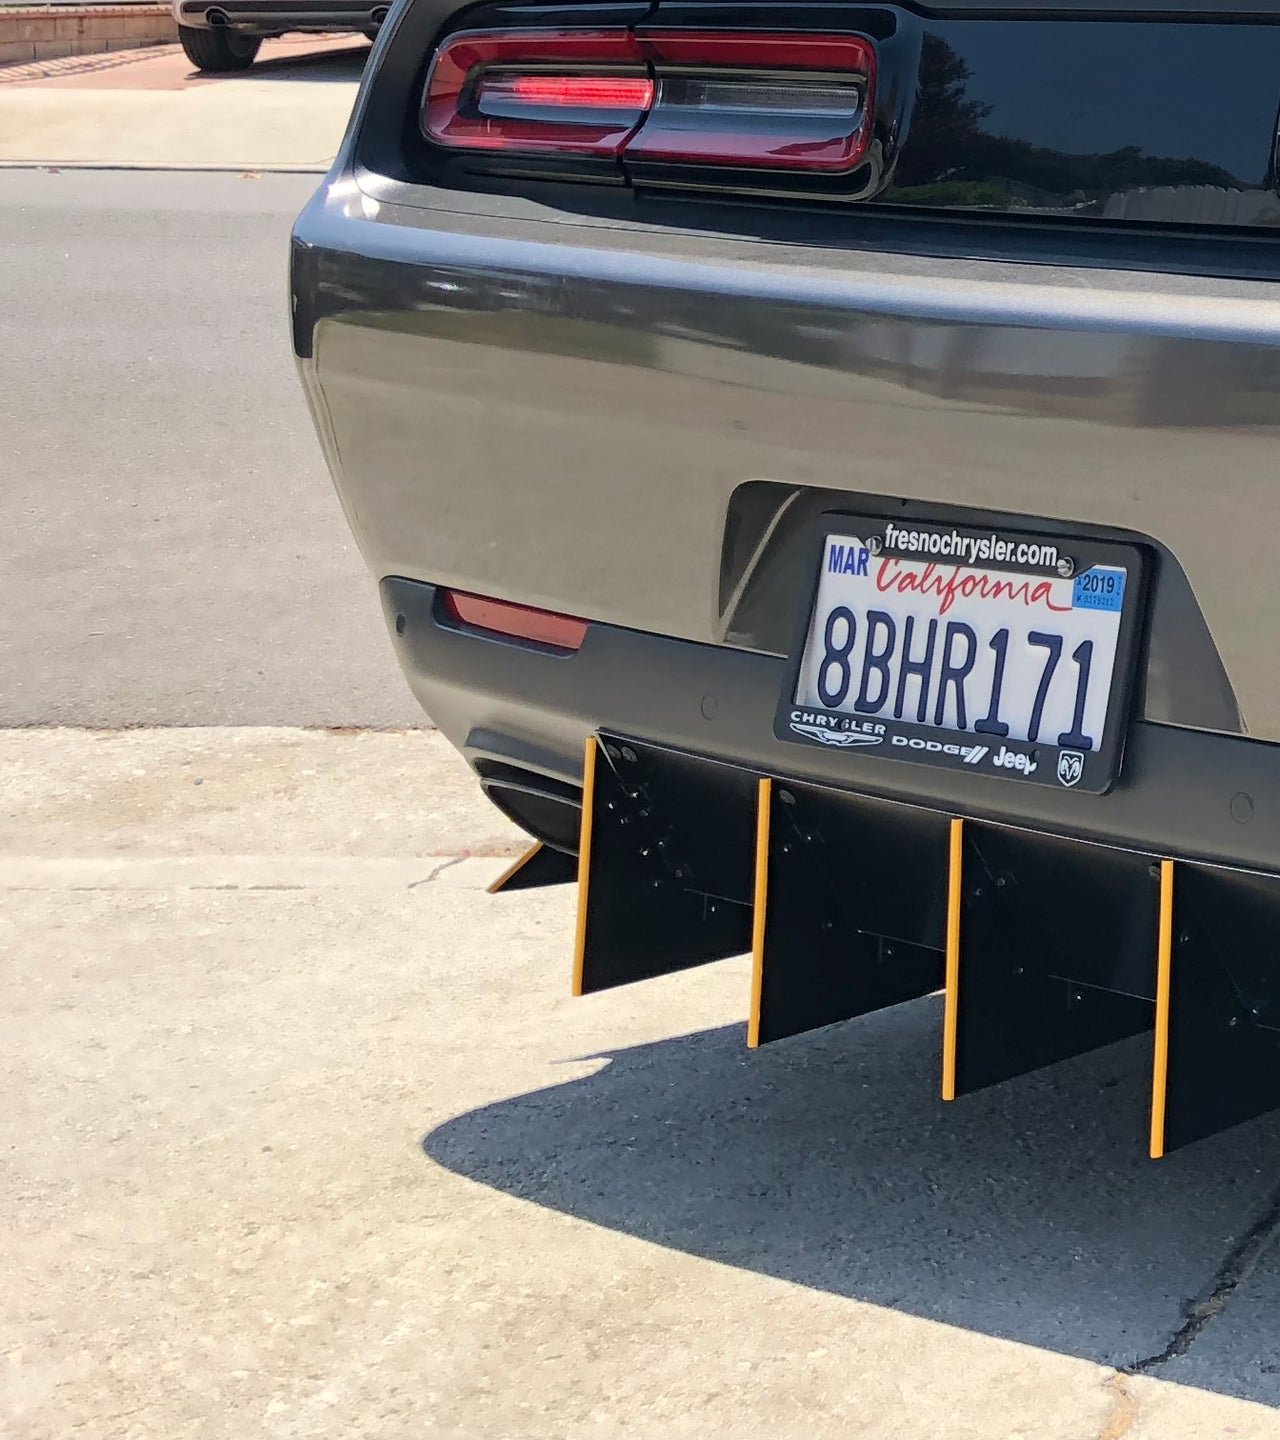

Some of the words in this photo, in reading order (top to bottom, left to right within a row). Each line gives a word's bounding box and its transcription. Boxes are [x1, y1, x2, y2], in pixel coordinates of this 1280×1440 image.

[828, 543, 870, 577] MAR
[885, 523, 1058, 566] fresnochrysler.com
[876, 557, 1073, 615] California
[1082, 573, 1115, 594] 2019
[817, 605, 1094, 751] 8BHR171
[891, 735, 974, 757] DODGE
[993, 745, 1038, 775] Jeep
